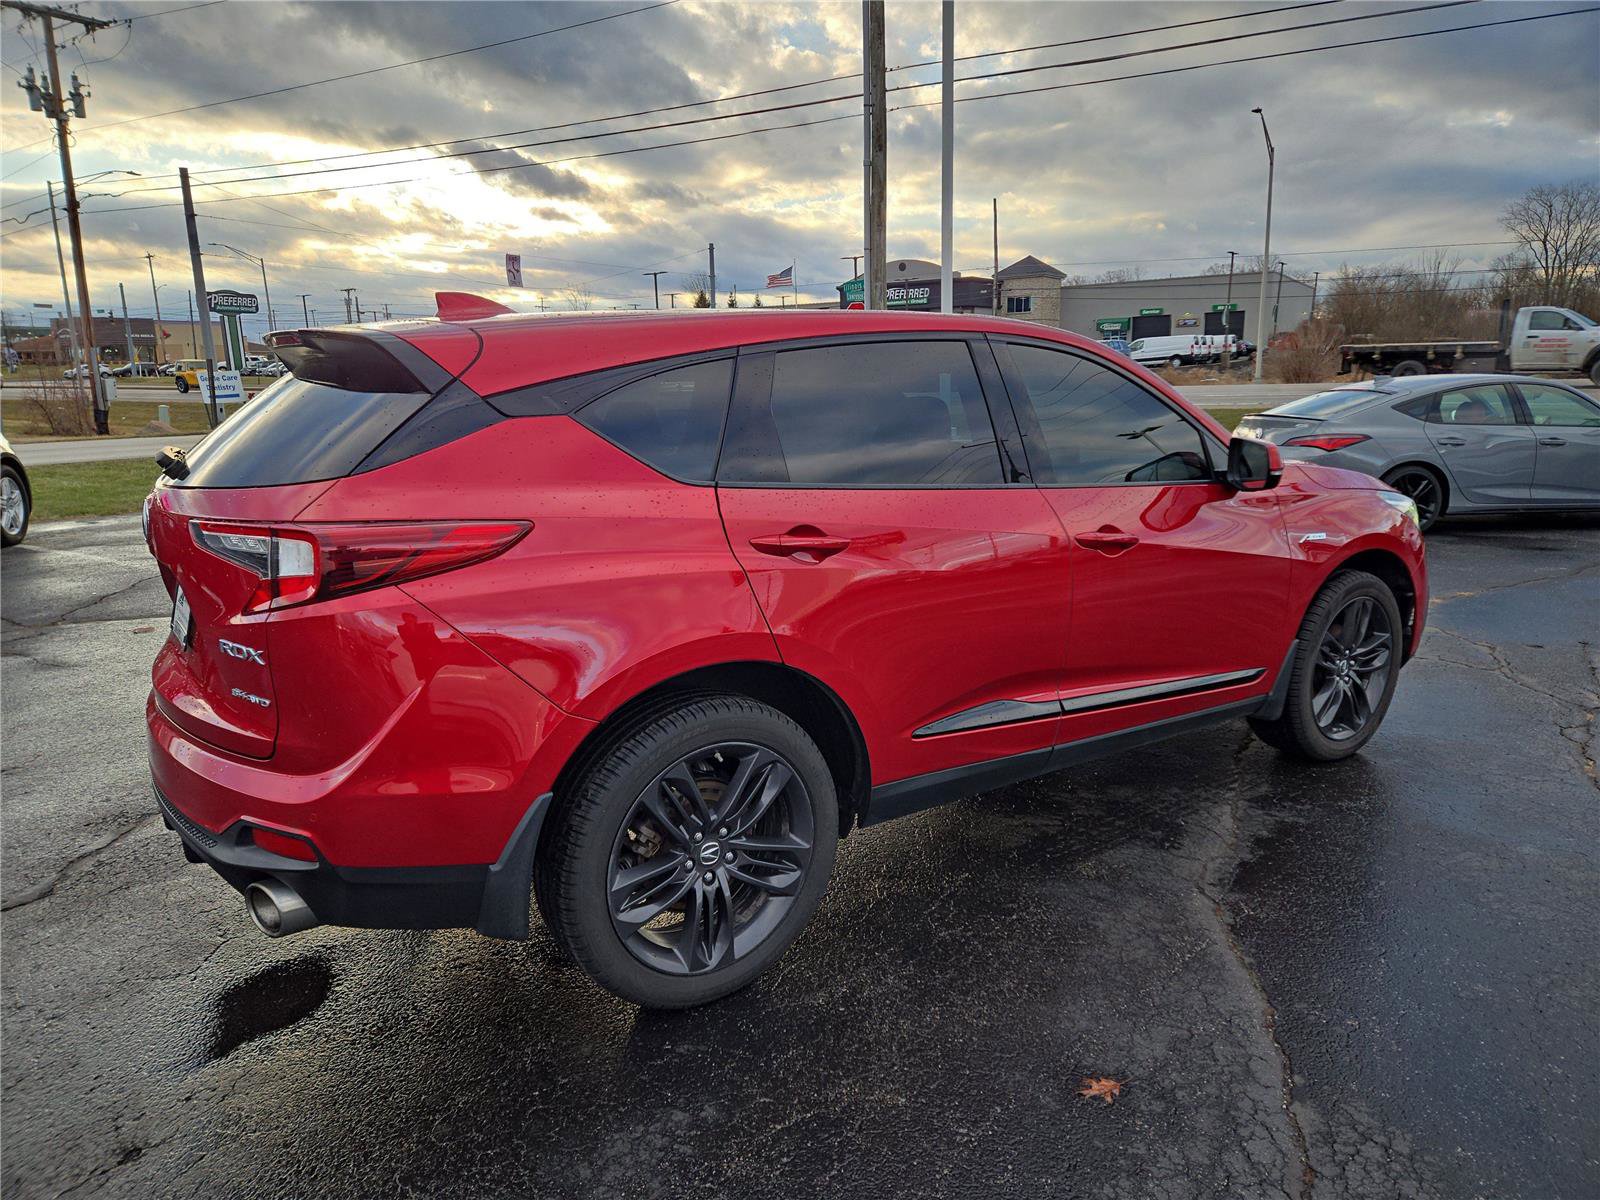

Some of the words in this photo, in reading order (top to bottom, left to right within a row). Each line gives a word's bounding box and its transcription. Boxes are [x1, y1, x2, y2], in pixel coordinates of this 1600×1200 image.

[211, 293, 257, 308] PREFERRED
[221, 374, 238, 382] Care
[218, 638, 266, 666] RDX
